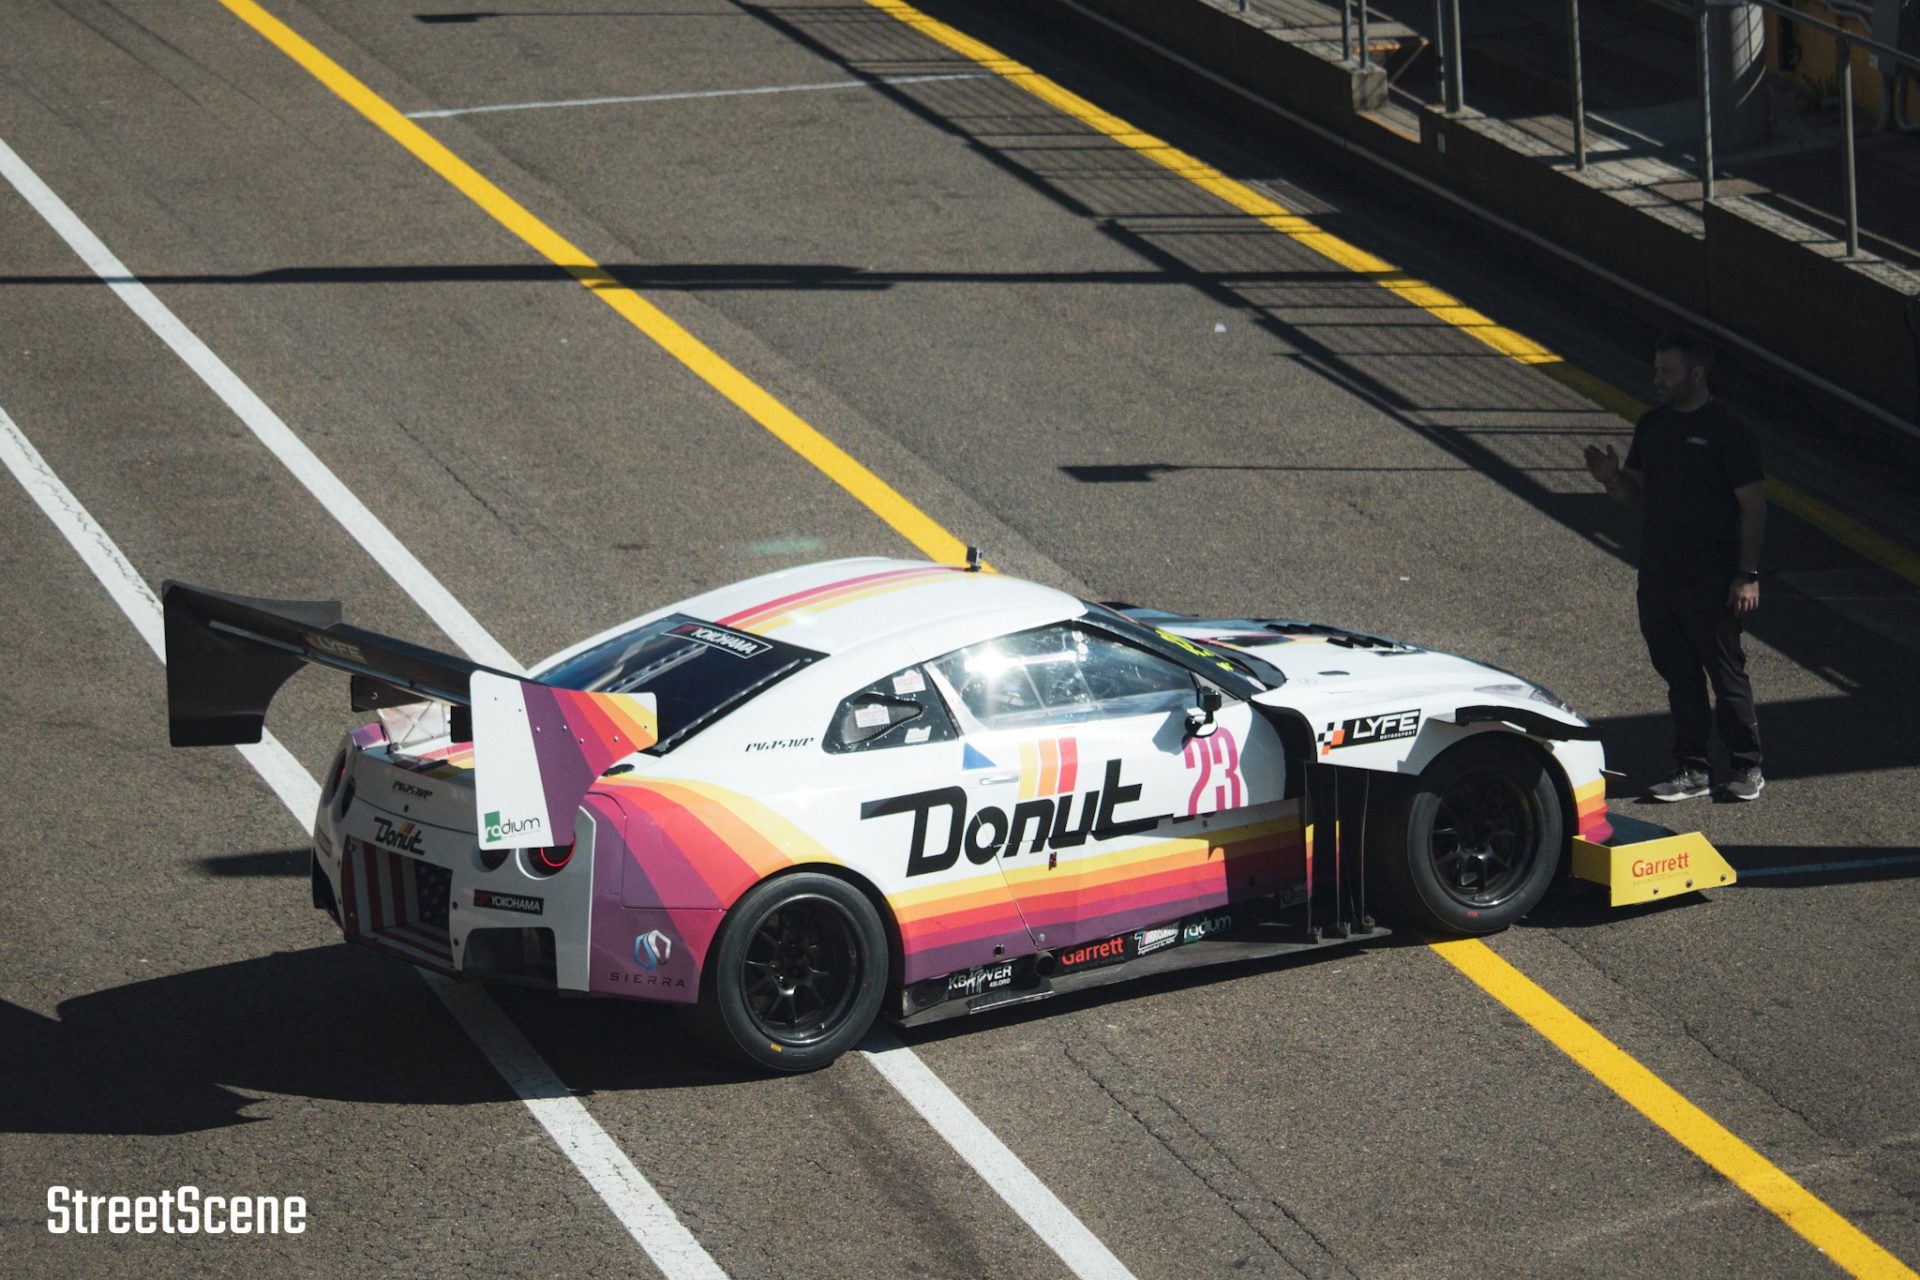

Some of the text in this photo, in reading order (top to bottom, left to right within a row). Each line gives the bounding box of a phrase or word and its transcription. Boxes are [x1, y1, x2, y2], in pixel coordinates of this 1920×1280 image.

[690, 627, 758, 654] YOKOHAMA
[1352, 711, 1420, 739] LYFE
[1177, 727, 1241, 822] 23
[485, 817, 541, 841] radium
[860, 758, 1174, 877] Donut
[374, 816, 425, 856] Donut
[1632, 852, 1689, 878] Garrett
[491, 895, 541, 912] YOKOHAMA
[1183, 916, 1232, 939] radium
[1061, 936, 1124, 965] Garrett
[609, 971, 686, 988] SIERRA
